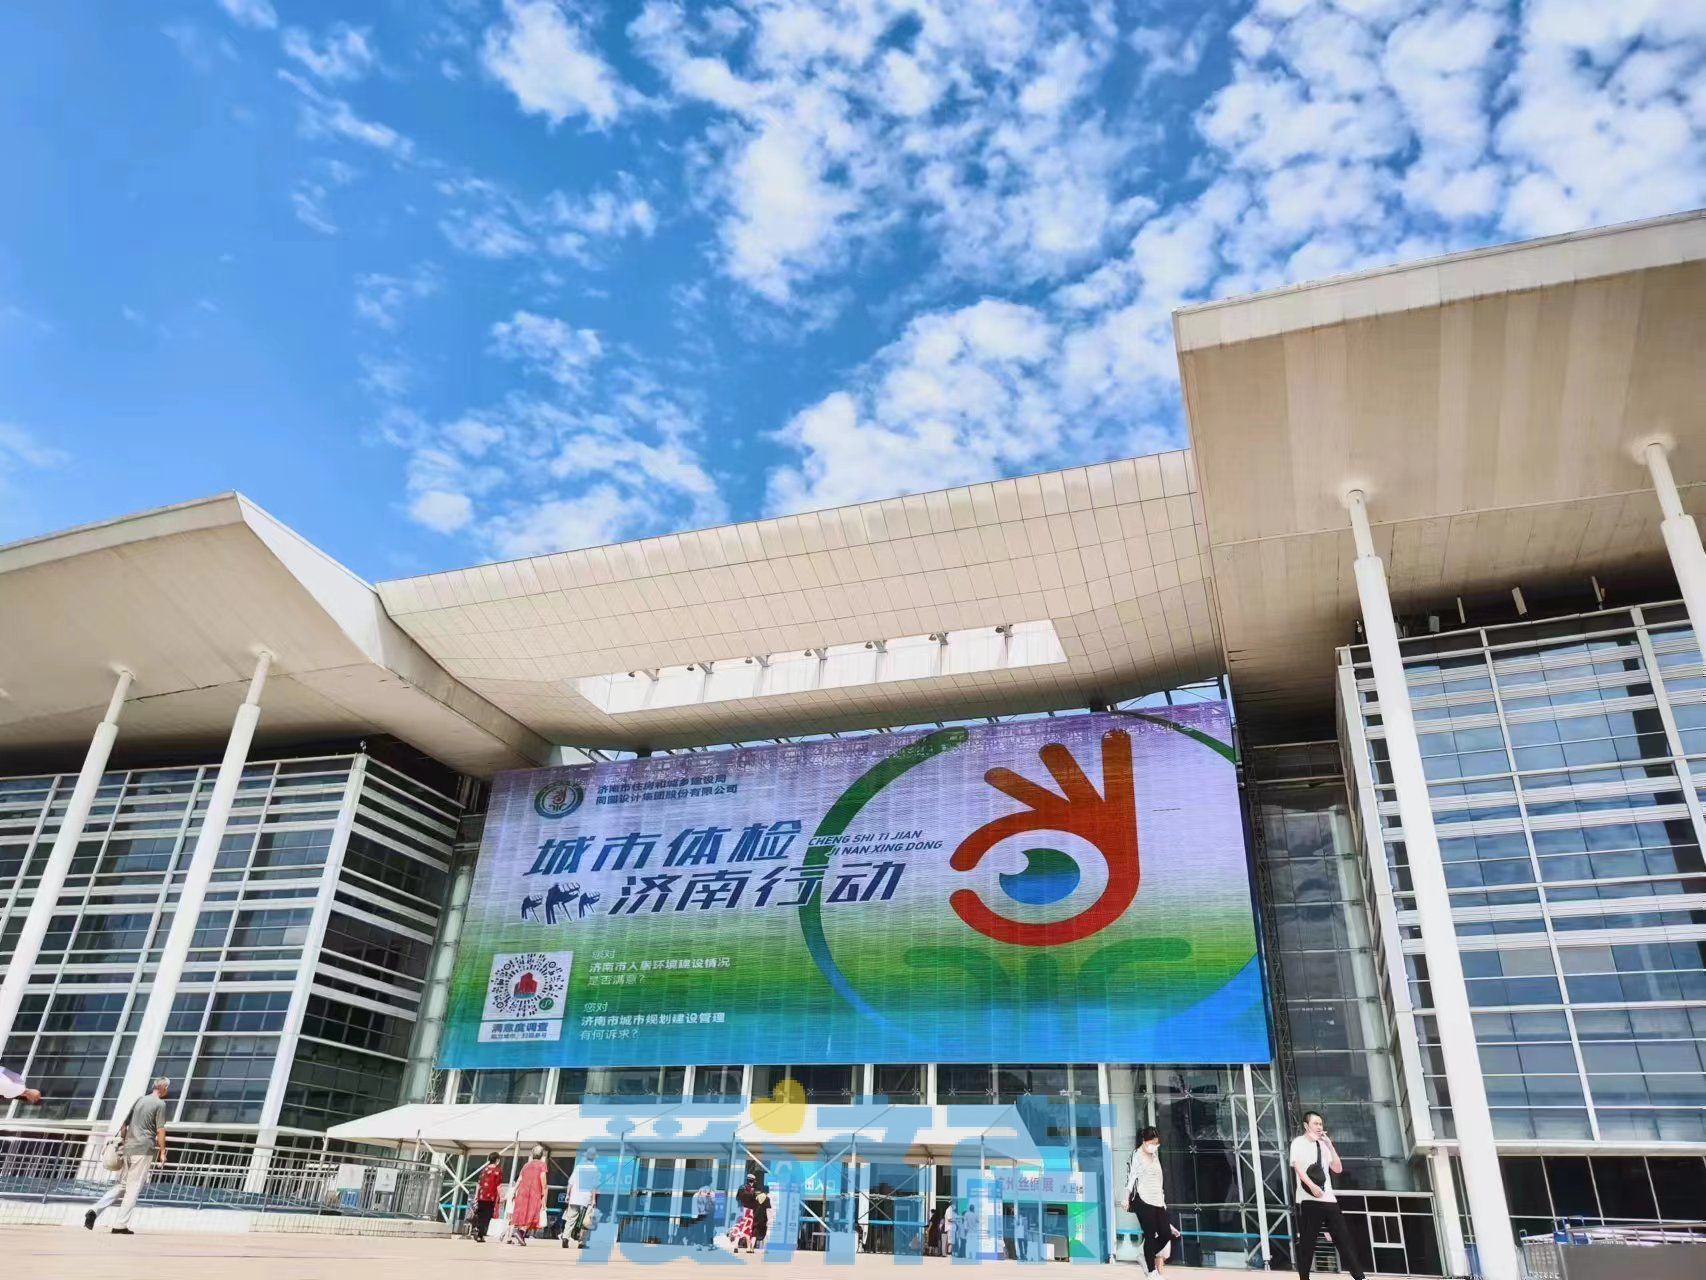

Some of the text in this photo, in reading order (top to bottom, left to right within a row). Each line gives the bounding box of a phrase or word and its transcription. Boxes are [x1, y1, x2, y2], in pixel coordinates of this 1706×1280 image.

[597, 774, 727, 795] 济南市住房和城乡建设局
[595, 783, 738, 806] 同圆设计集团股份有限公司
[808, 830, 923, 846] CHENG SHI TI JIAN
[523, 819, 803, 877] 城市体检
[827, 841, 943, 856] JI NAN XING DONG
[609, 861, 906, 916] 济南行动
[589, 957, 731, 973] 济南市人居环境建设情况
[584, 1002, 608, 1013] 您对
[492, 1022, 549, 1033] 满意度调查
[581, 1012, 726, 1027] 济南市城市规划建设管理
